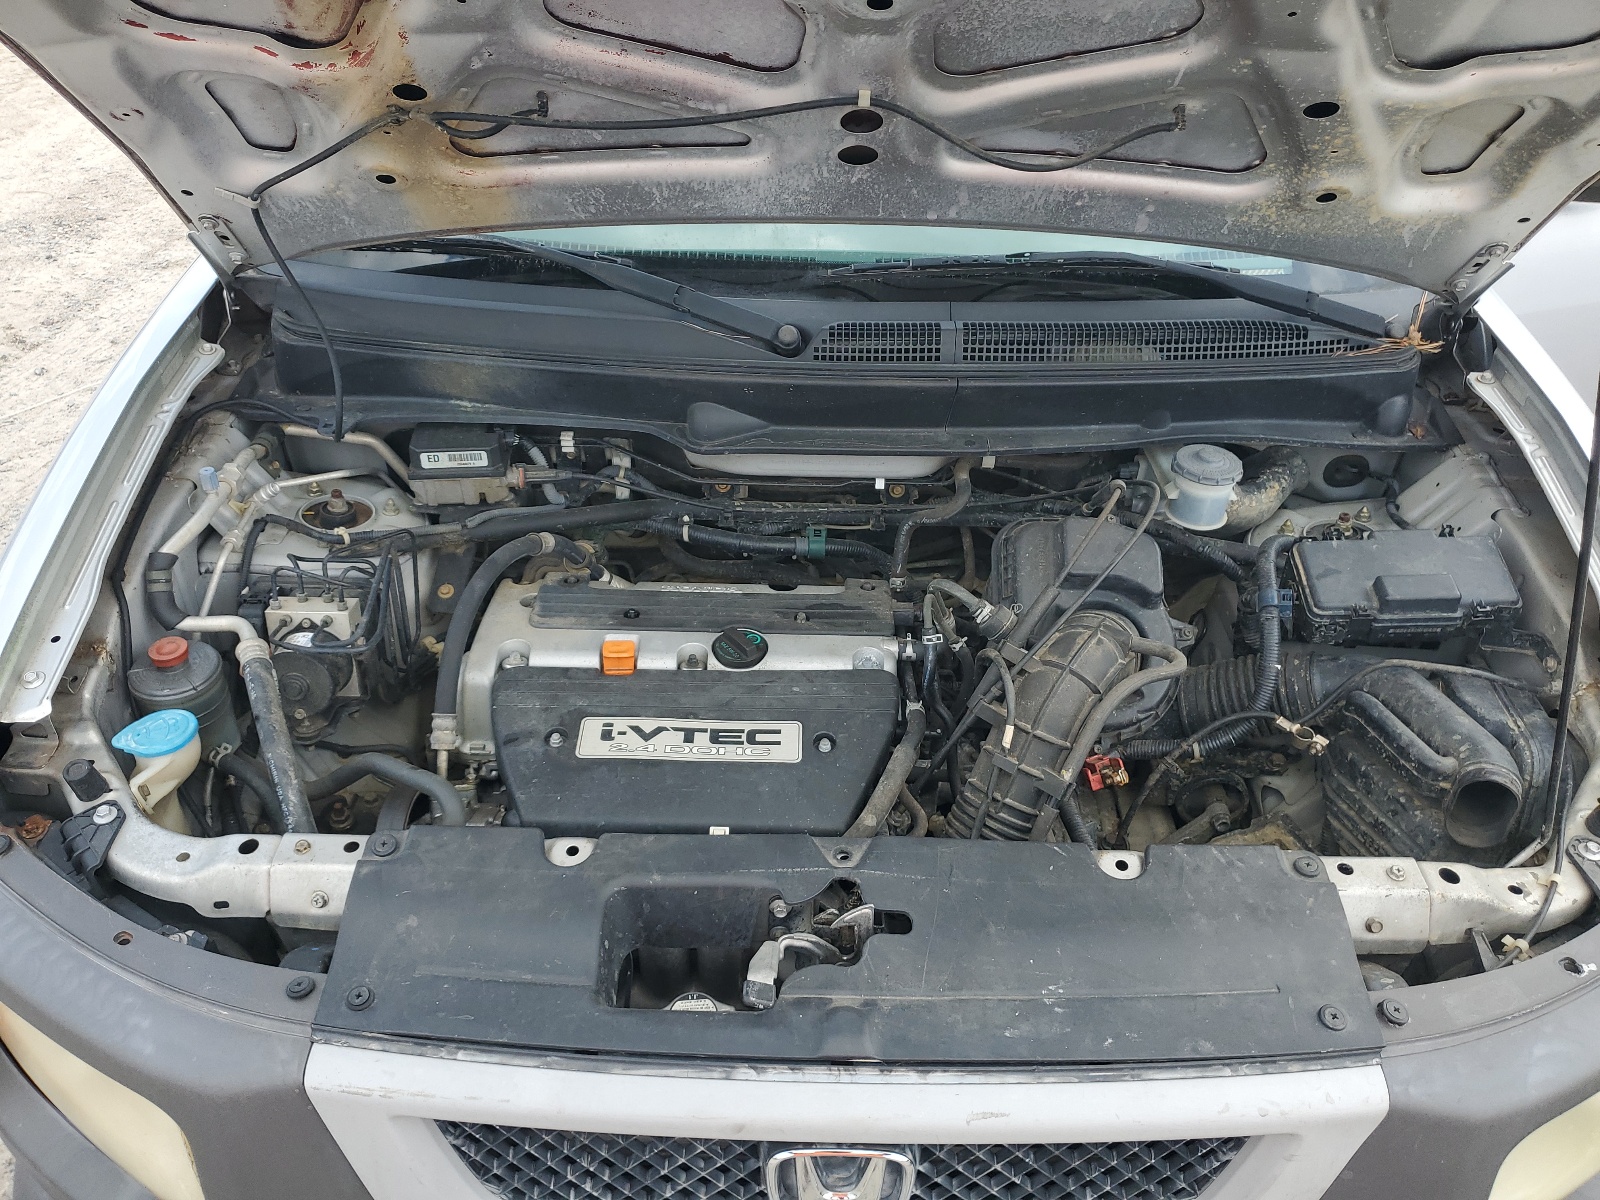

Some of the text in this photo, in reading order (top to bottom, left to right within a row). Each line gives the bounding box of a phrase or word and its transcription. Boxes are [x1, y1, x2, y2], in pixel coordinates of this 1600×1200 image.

[426, 454, 440, 463] ED
[600, 722, 782, 745] i-VTEC
[607, 743, 771, 757] 2.4 DOHC
